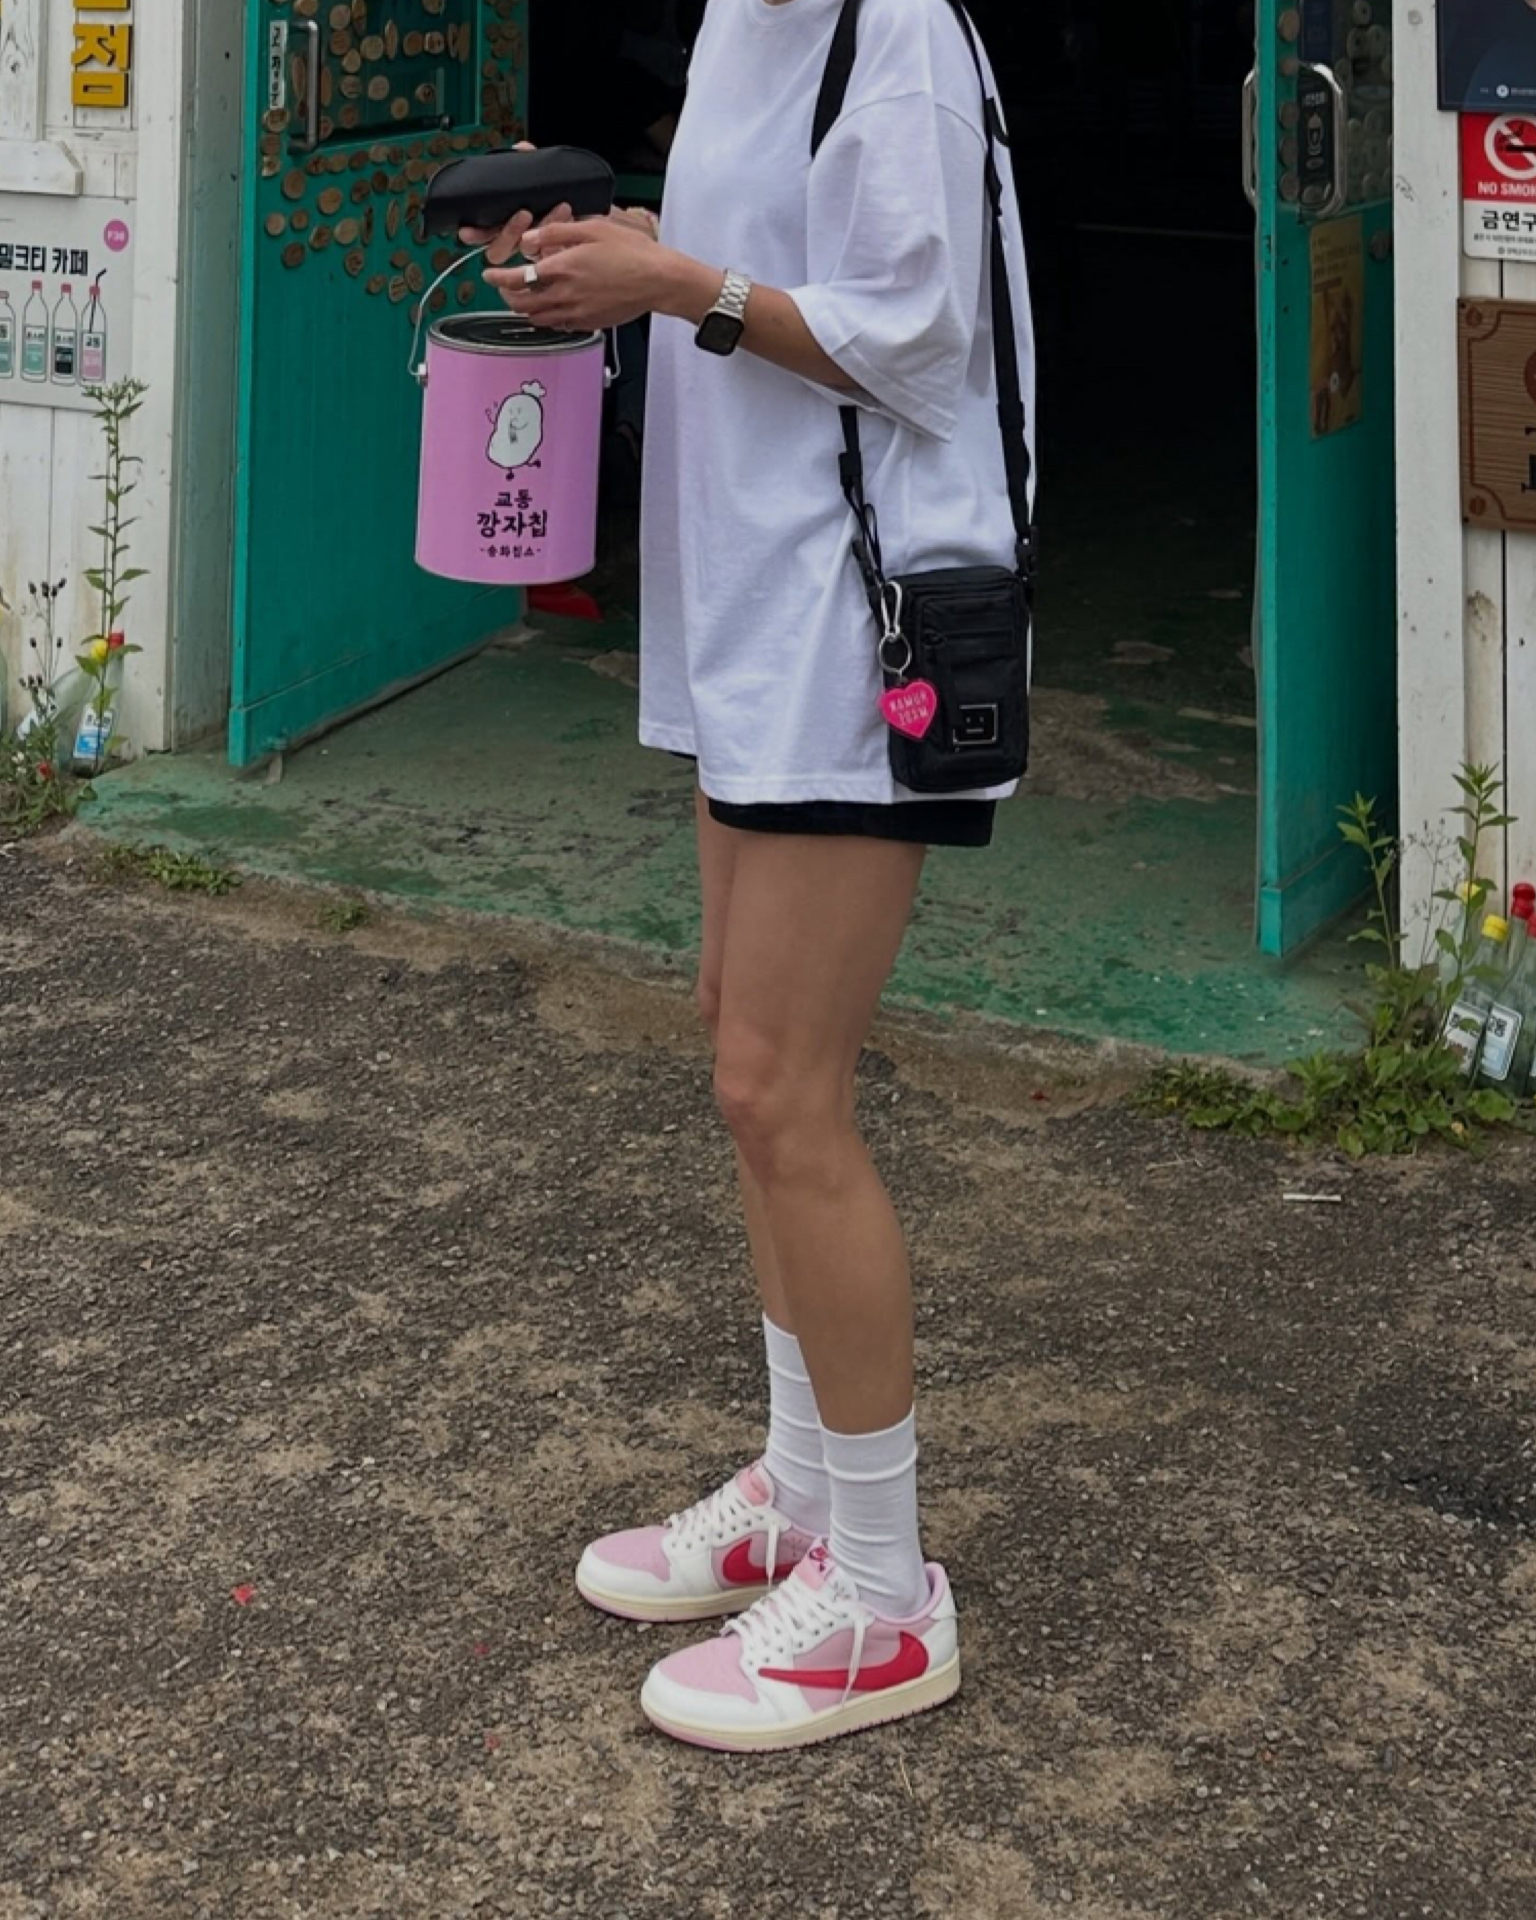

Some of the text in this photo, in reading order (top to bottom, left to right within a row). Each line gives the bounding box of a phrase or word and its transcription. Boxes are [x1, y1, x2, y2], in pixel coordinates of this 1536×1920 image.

[72, 0, 132, 107] 점
[1478, 181, 1498, 195] NO
[52, 247, 88, 276] 카페
[477, 510, 547, 538] 깡자칩
